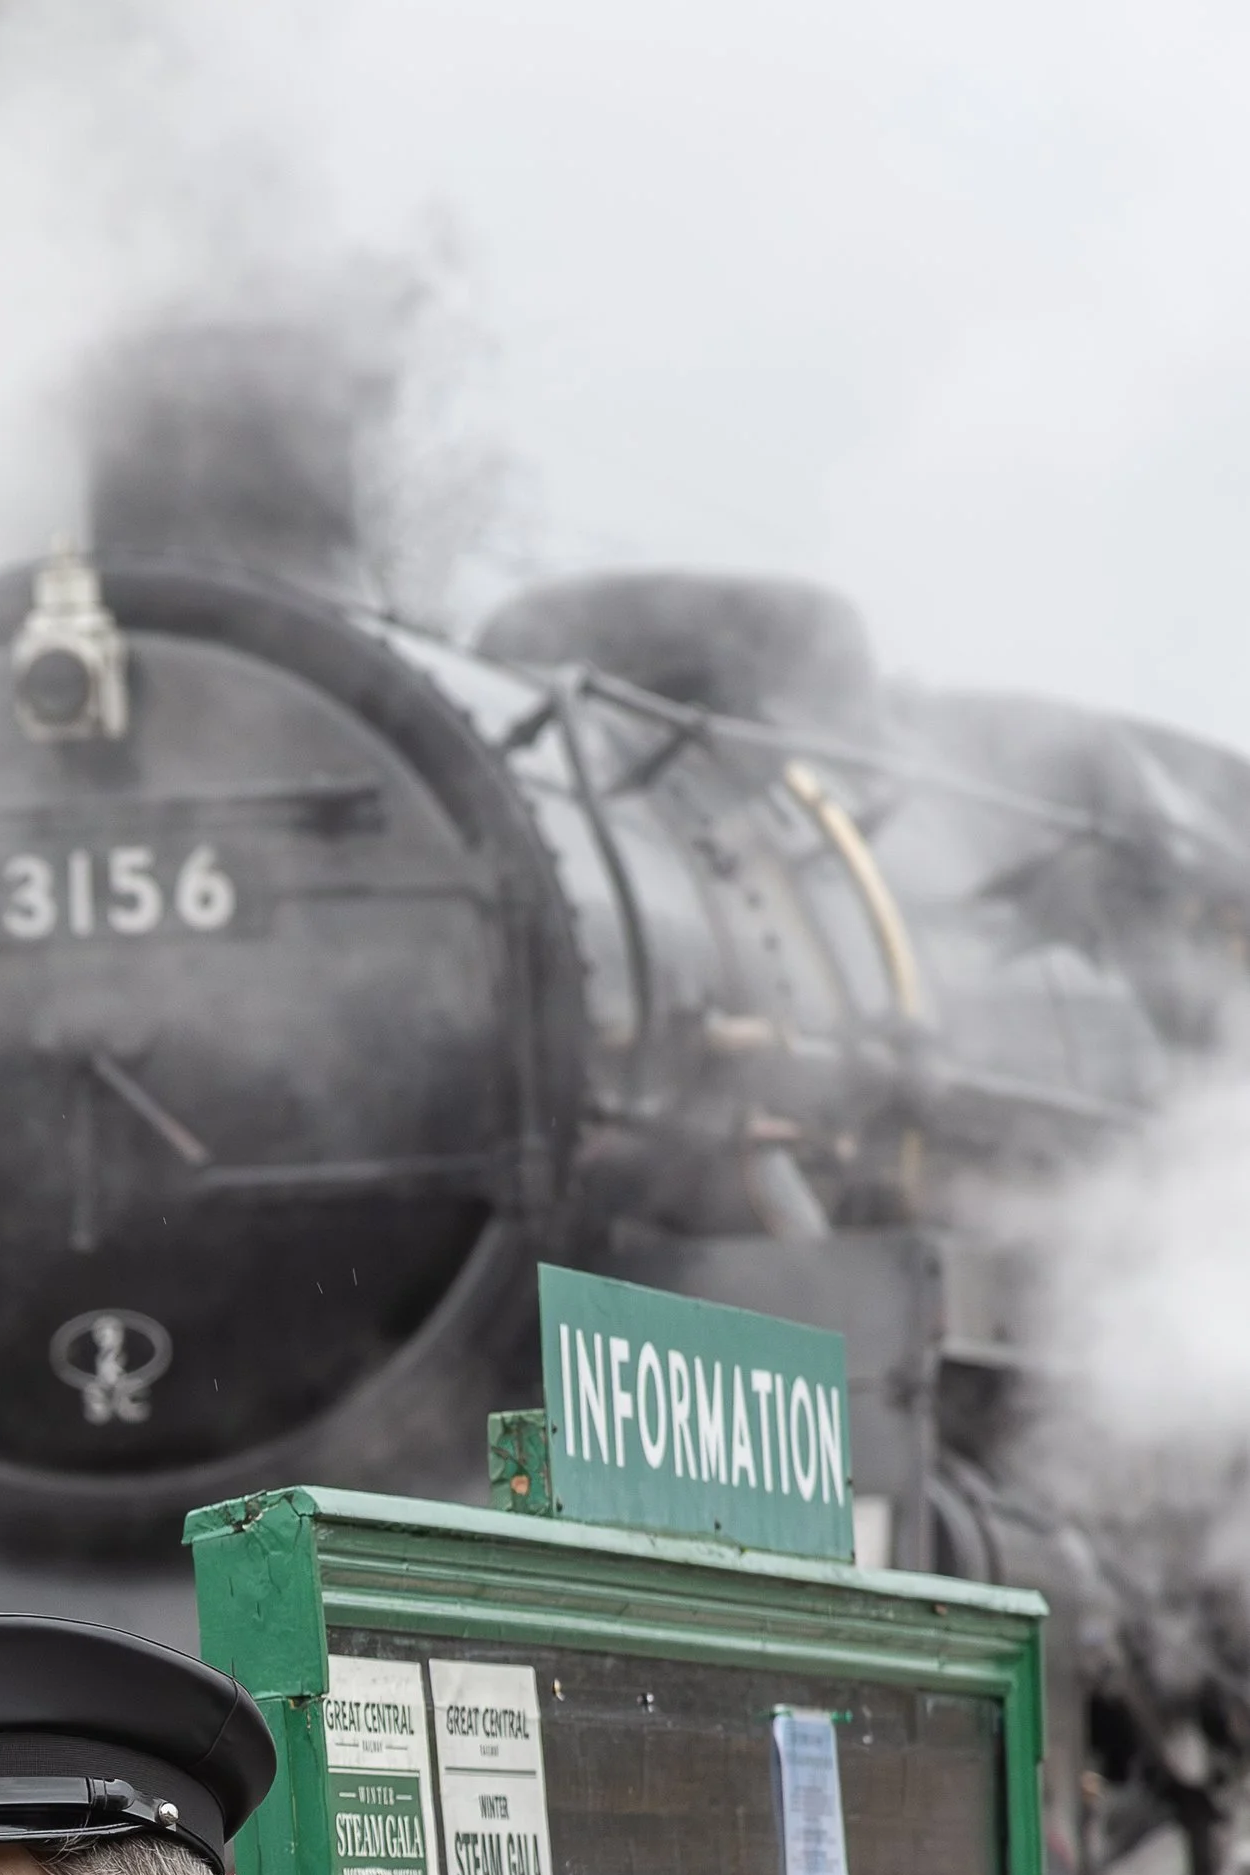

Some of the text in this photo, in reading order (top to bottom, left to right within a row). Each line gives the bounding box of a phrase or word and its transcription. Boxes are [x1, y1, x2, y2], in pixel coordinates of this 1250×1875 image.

[560, 1324, 844, 1507] INFORMATION
[325, 1699, 415, 1735] GREAT CENTRAL
[446, 1705, 530, 1740] GREAT CENTRAL
[358, 1785, 395, 1806] WINTER
[478, 1794, 510, 1820] WINTER
[335, 1812, 424, 1859] STEAM GALA
